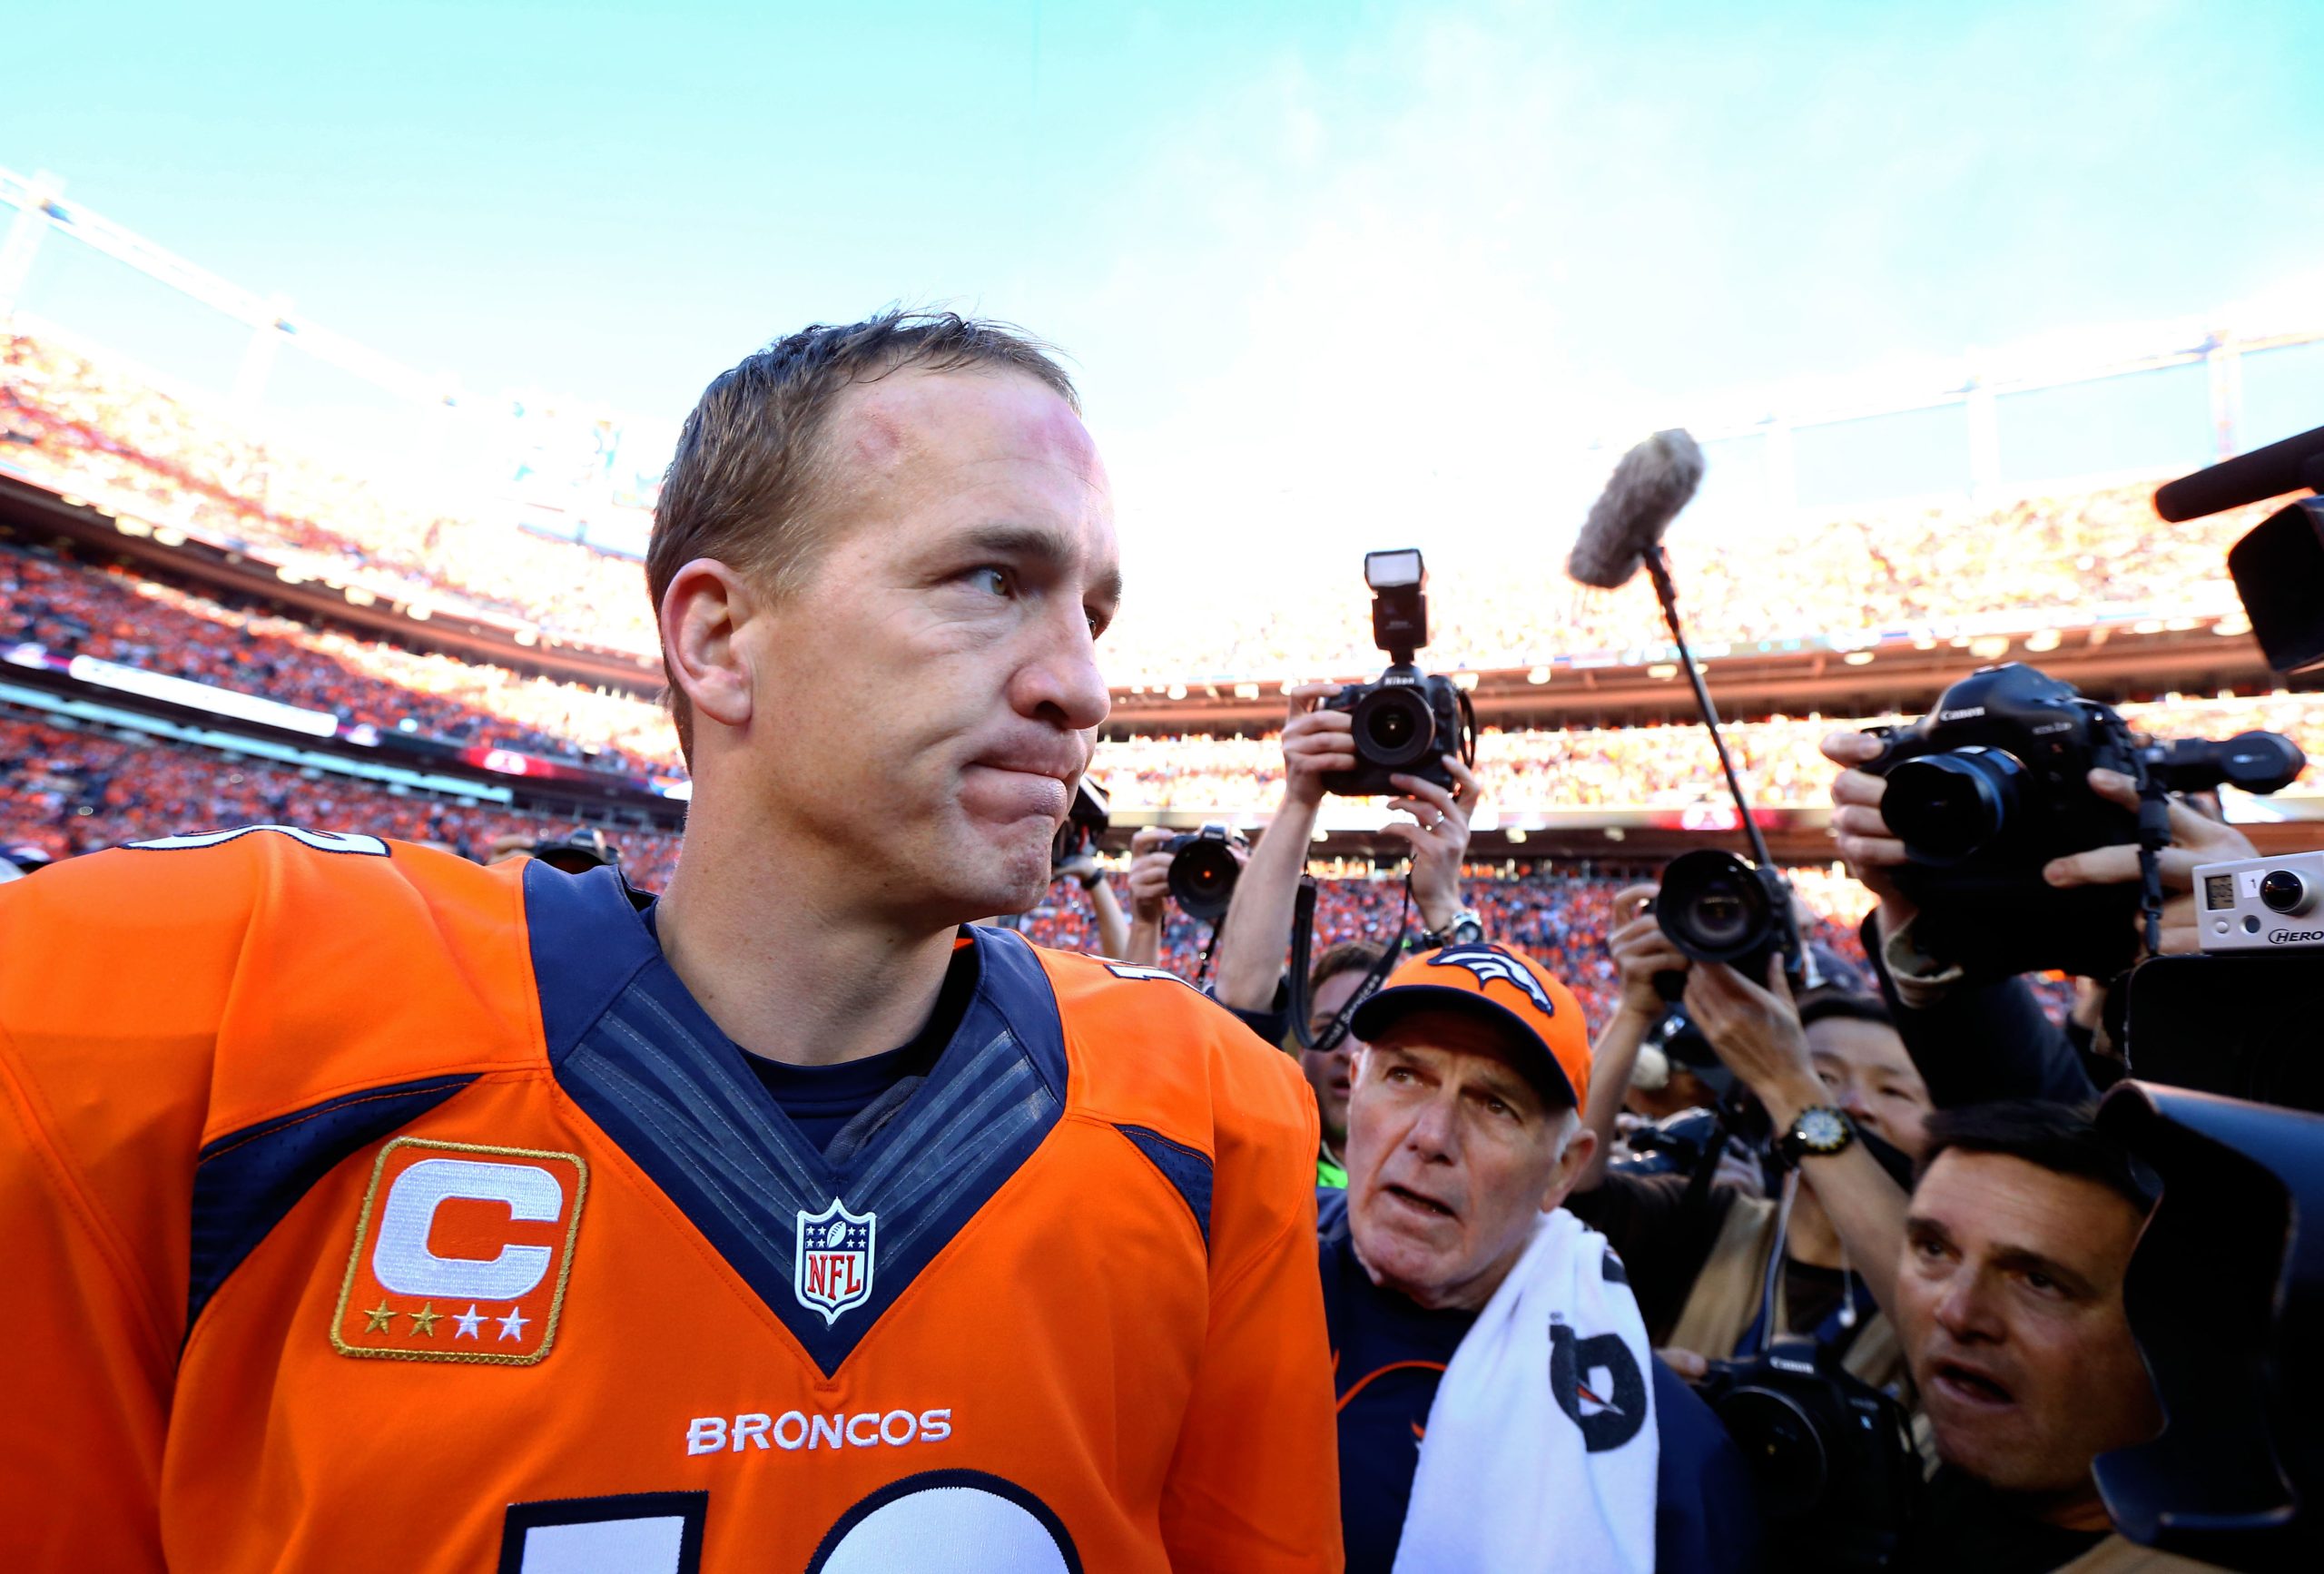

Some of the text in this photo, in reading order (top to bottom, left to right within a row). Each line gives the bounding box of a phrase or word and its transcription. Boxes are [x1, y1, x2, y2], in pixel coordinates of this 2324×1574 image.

[1384, 676, 1414, 685] Nikon
[1940, 706, 1985, 722] Canon
[2276, 930, 2324, 942] HERO
[372, 1158, 563, 1301] C
[807, 1254, 862, 1301] NFL
[686, 1408, 952, 1456] BRONCOS
